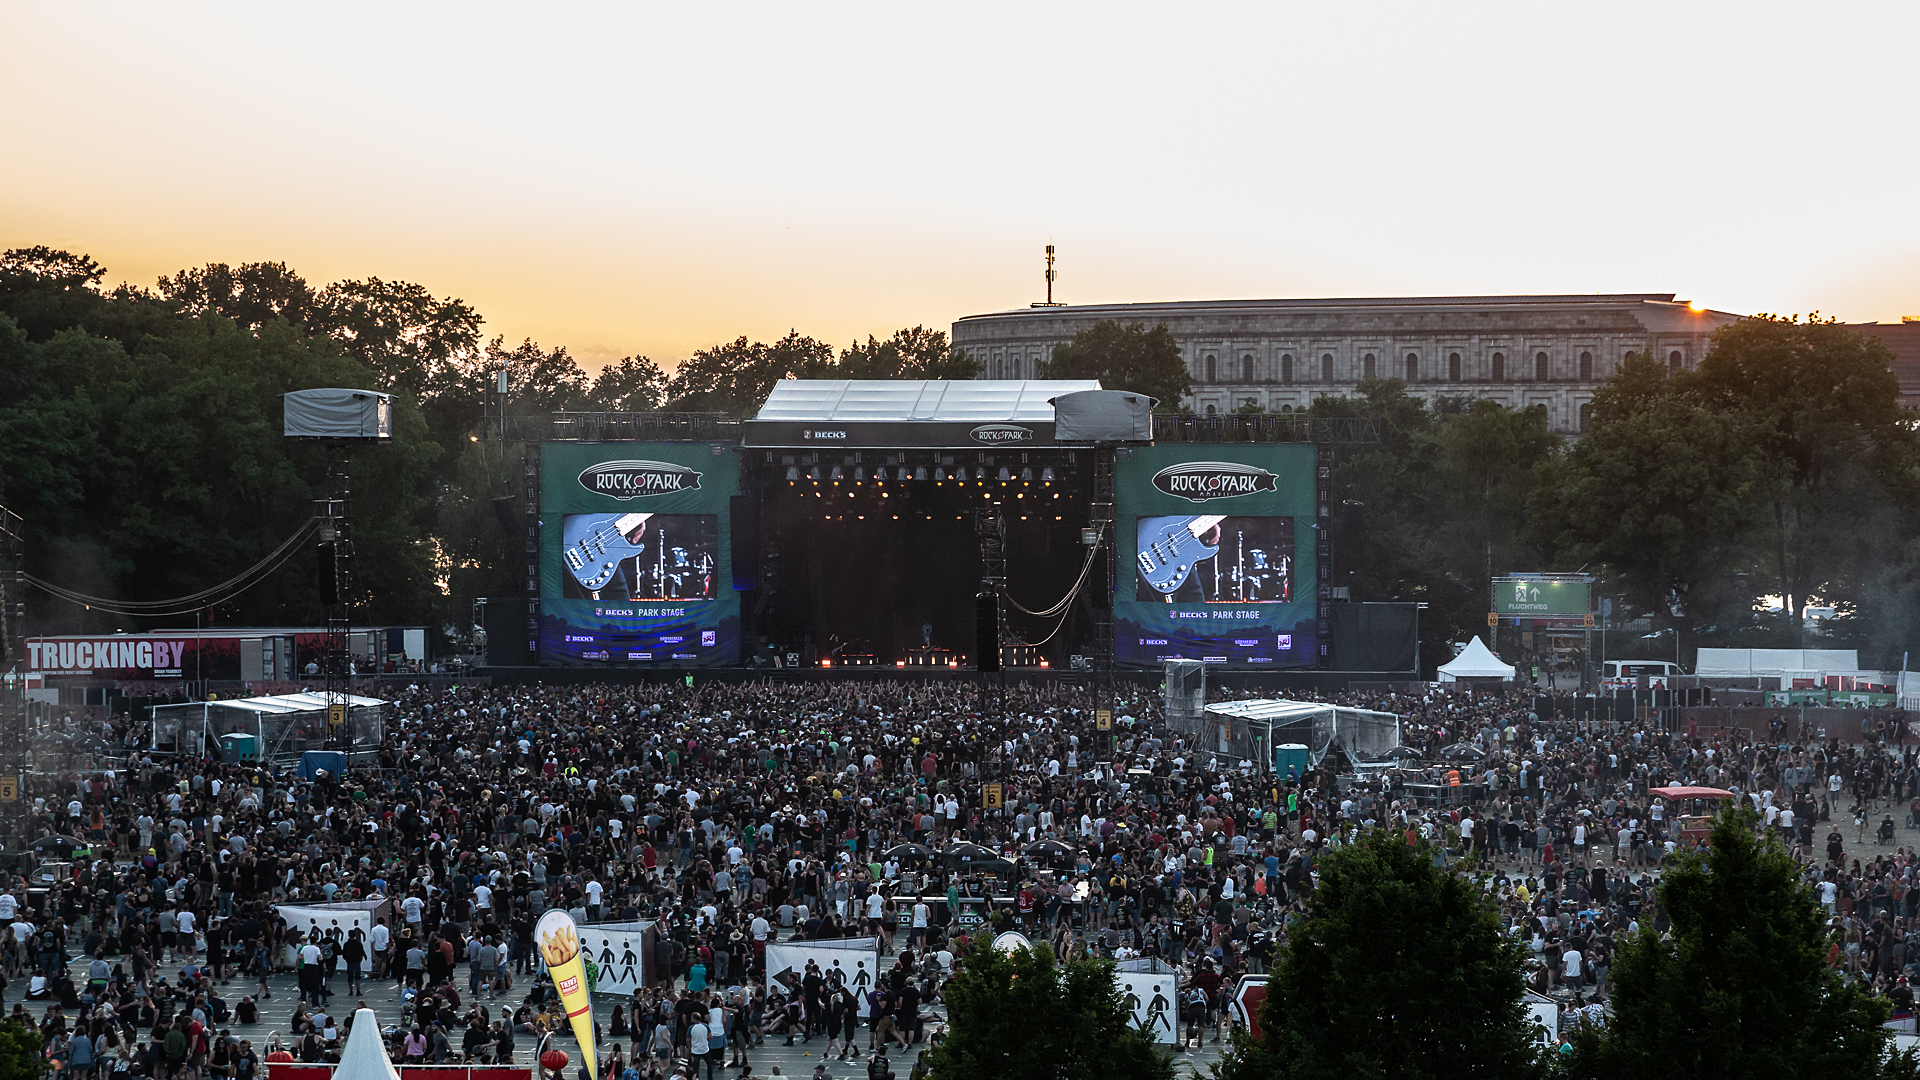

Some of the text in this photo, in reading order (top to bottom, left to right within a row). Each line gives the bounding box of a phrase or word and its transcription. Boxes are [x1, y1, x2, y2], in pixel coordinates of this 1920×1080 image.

[814, 430, 847, 439] BECK'S
[979, 431, 1023, 440] ROCK PARK
[596, 473, 683, 489] ROCK PARK
[1170, 475, 1258, 491] ROCK PARK
[638, 608, 659, 617] PARK
[661, 608, 685, 617] STAGE
[1179, 610, 1260, 619] BECK'S PARK STAGE
[333, 712, 340, 721] 3
[1100, 717, 1107, 727] 4
[3, 786, 11, 797] 5
[988, 793, 996, 804] 6
